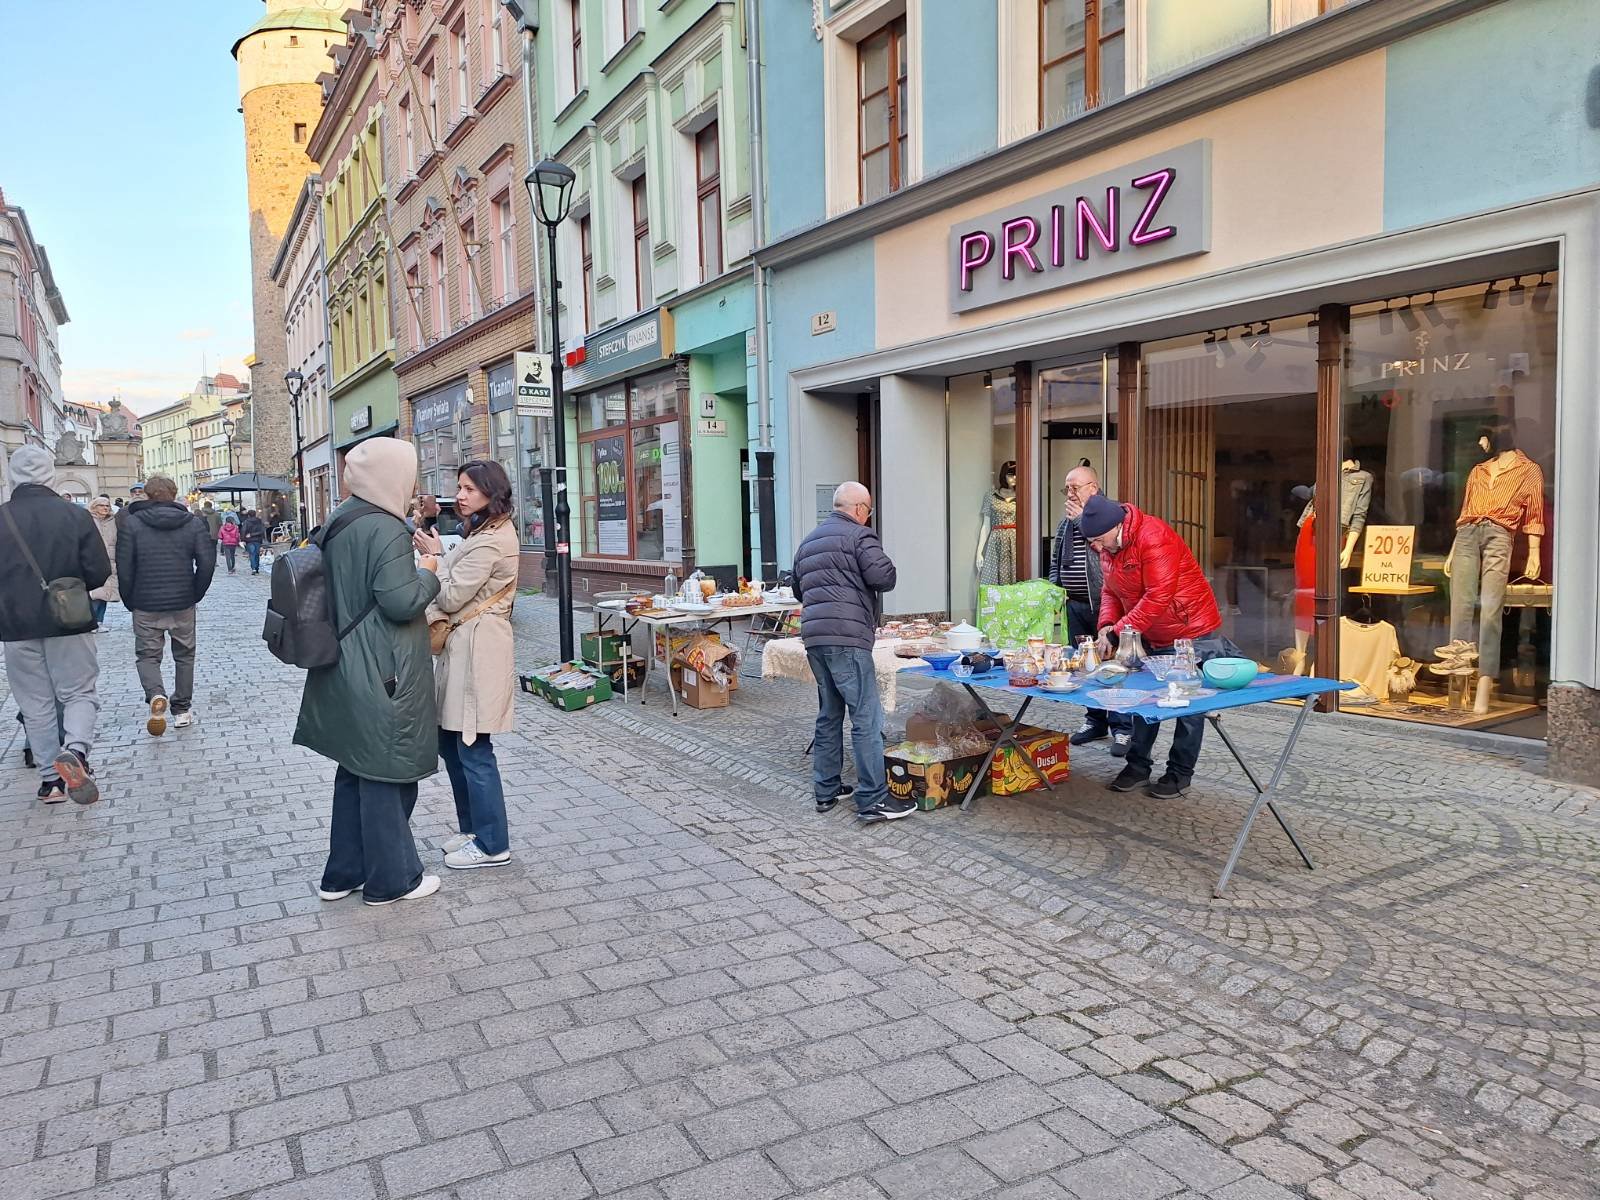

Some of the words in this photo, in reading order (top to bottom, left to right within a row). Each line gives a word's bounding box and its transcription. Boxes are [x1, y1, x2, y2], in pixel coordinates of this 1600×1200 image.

[960, 168, 1177, 292] PRINZ
[818, 313, 829, 326] 12
[599, 336, 627, 359] STEFCZYK
[629, 326, 655, 346] FINANSE
[1381, 352, 1471, 379] PRINZ
[489, 376, 515, 399] Tkaniny
[528, 388, 549, 396] KASY
[705, 400, 714, 410] 14
[707, 421, 717, 429] 14
[1072, 427, 1100, 436] PRINZ
[1365, 572, 1409, 583] KURTKI
[1036, 752, 1059, 768] Dusal
